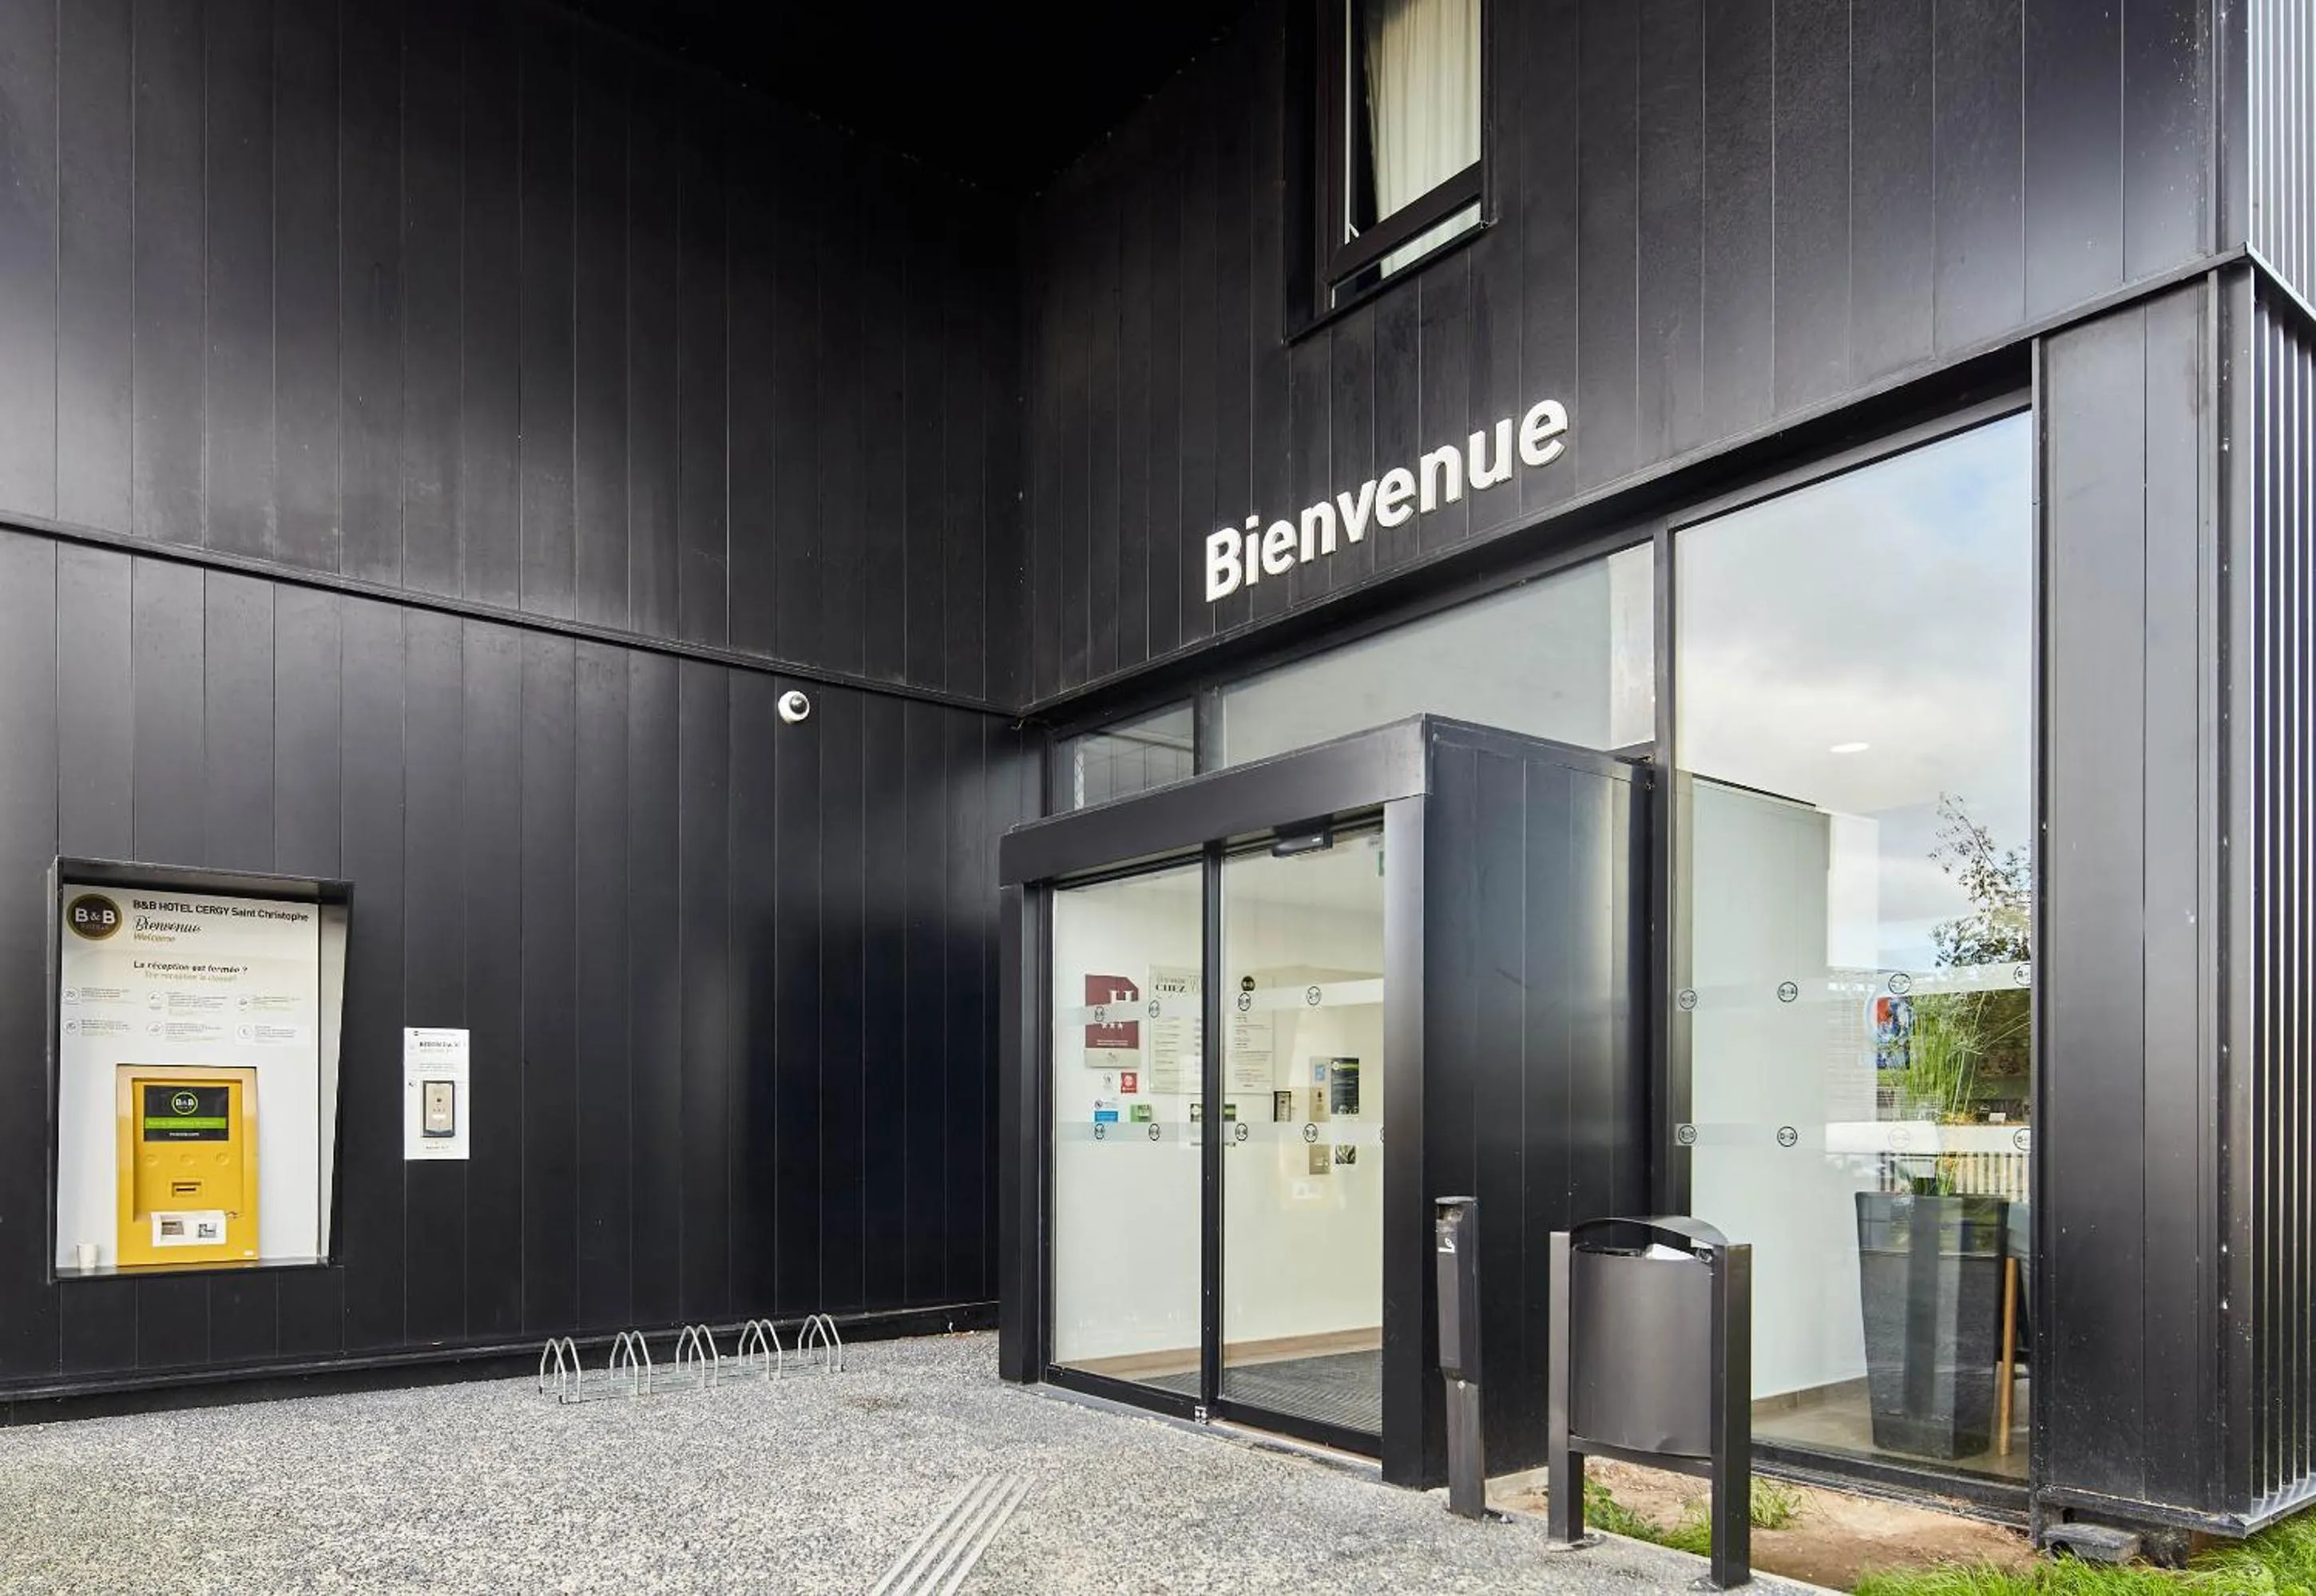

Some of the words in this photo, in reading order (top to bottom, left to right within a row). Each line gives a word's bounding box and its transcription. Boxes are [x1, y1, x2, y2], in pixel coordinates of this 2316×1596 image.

[1205, 399, 1568, 603] Bienvenue
[133, 899, 157, 910] B&B
[158, 902, 193, 913] HOTEL
[196, 905, 230, 916] CERGY
[231, 907, 256, 918] Saint
[257, 909, 310, 922] Christophe
[133, 914, 202, 933] Bienvenue
